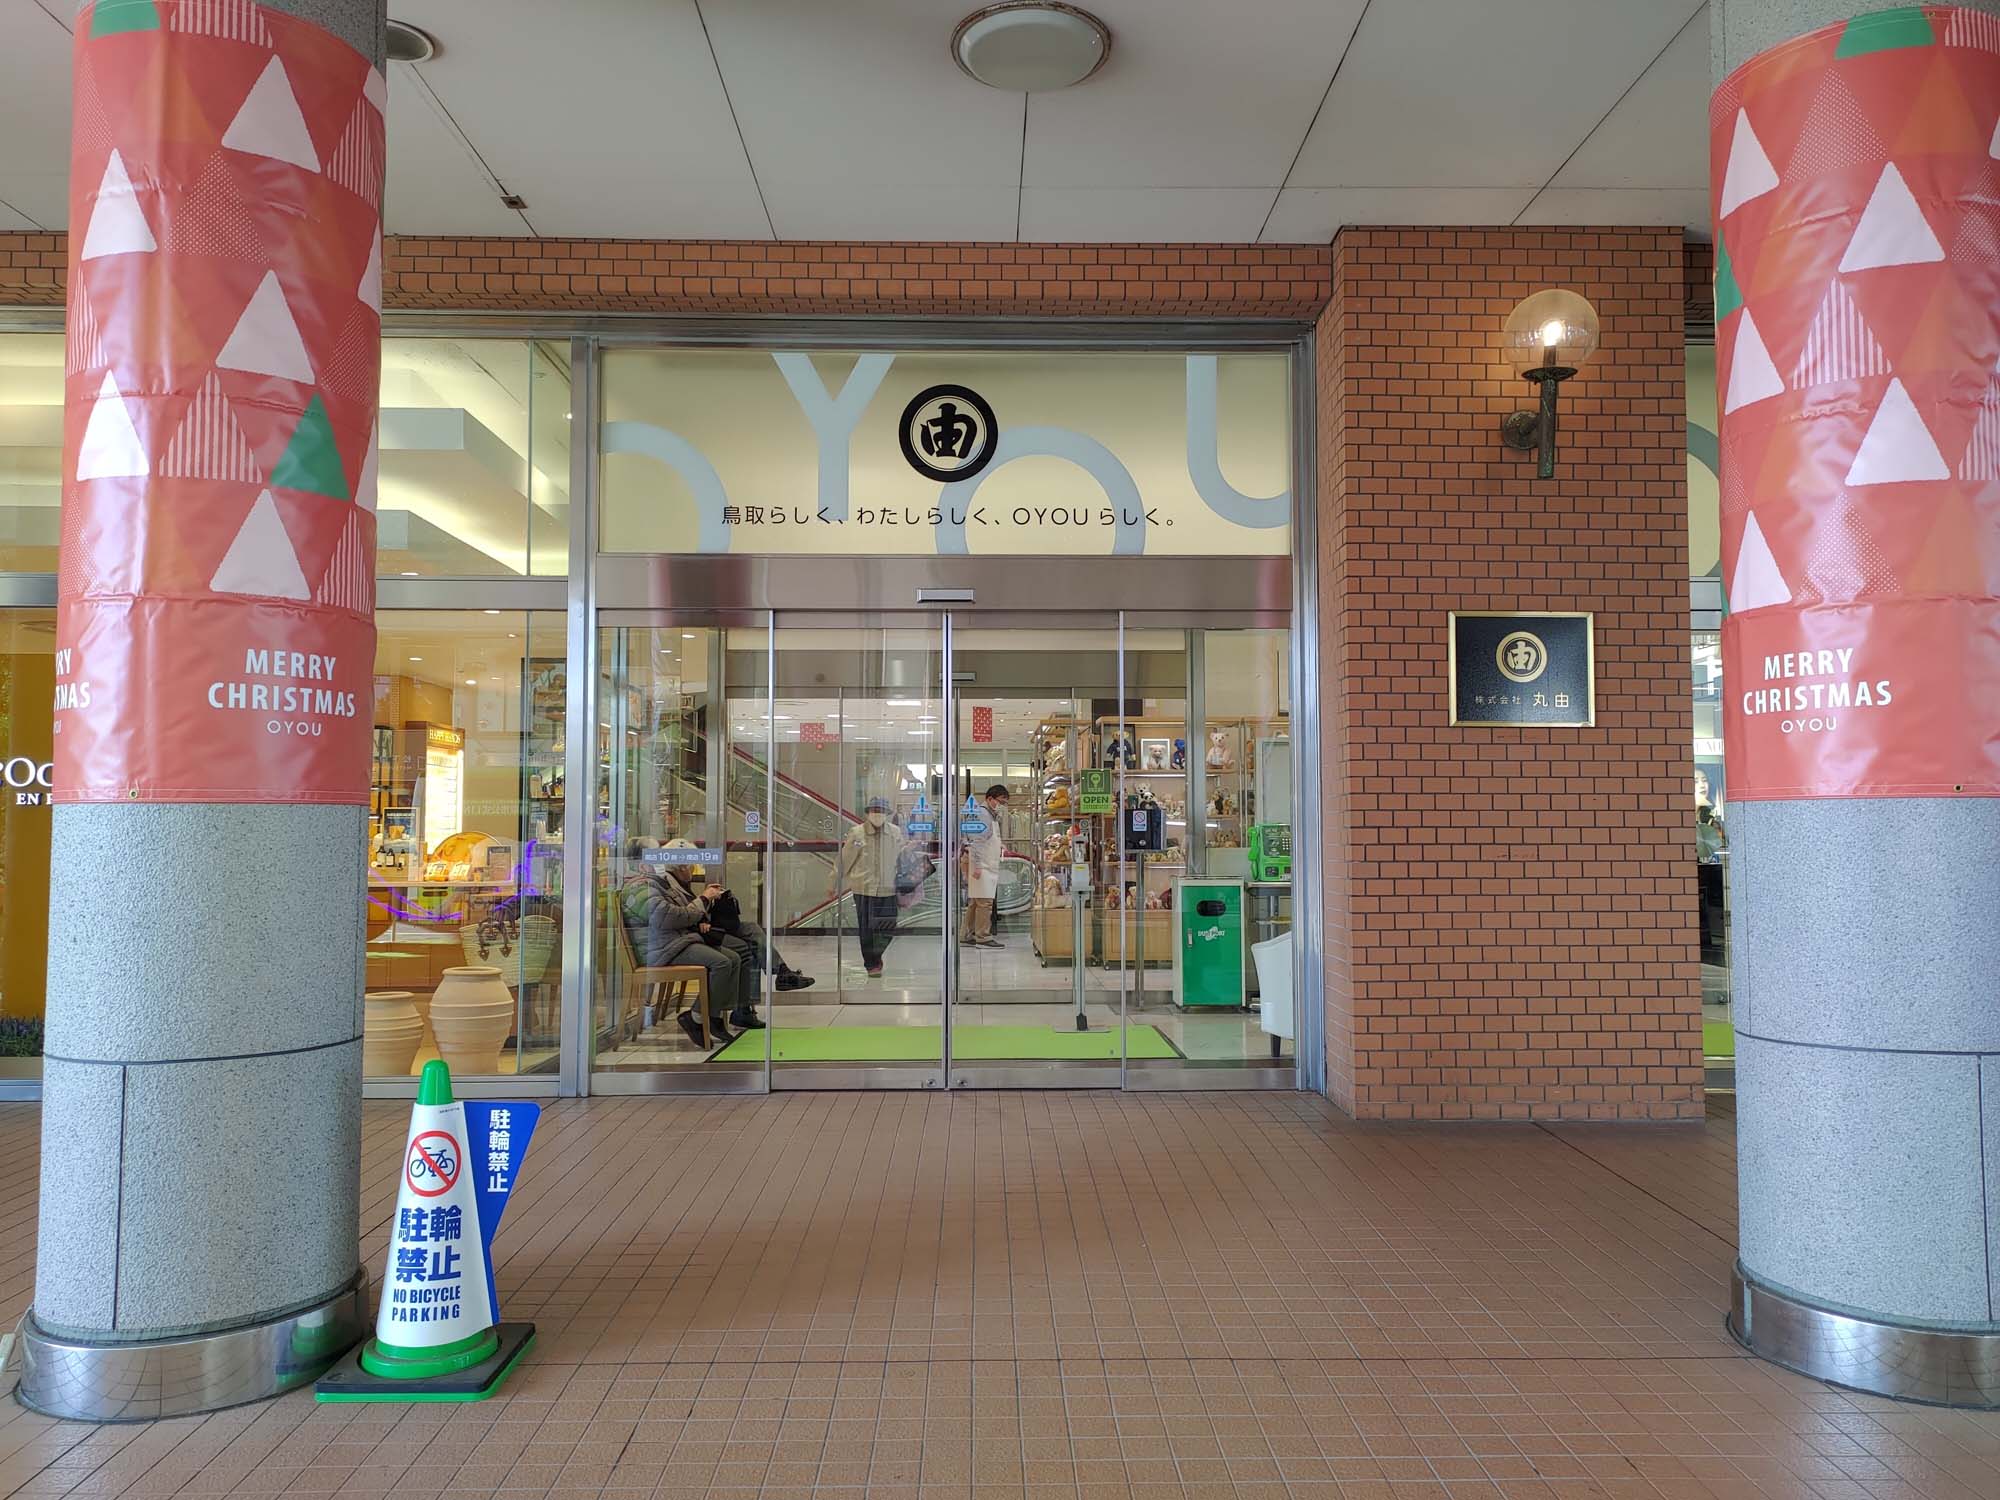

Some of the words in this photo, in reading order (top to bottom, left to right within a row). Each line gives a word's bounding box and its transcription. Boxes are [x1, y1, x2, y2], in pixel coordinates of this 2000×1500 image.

[56, 648, 72, 676] RY
[245, 649, 336, 681] MERRY
[1764, 647, 1853, 680] MERRY
[208, 682, 355, 718] CHRISTMAS
[1475, 695, 1521, 705] 株式会社
[1533, 692, 1569, 708] 丸由
[1743, 680, 1893, 715] CHRISTMAS
[267, 720, 322, 736] OYOU
[1781, 717, 1837, 733] OYOU
[16, 793, 40, 805] EN
[1083, 796, 1109, 804] OPEN
[488, 1109, 511, 1193] 駐輪禁止
[398, 1205, 462, 1242] 駐輪
[396, 1246, 461, 1283] 禁止
[393, 1288, 407, 1303] NO
[410, 1285, 461, 1303] BICYCLE
[392, 1304, 460, 1322] PARKING
